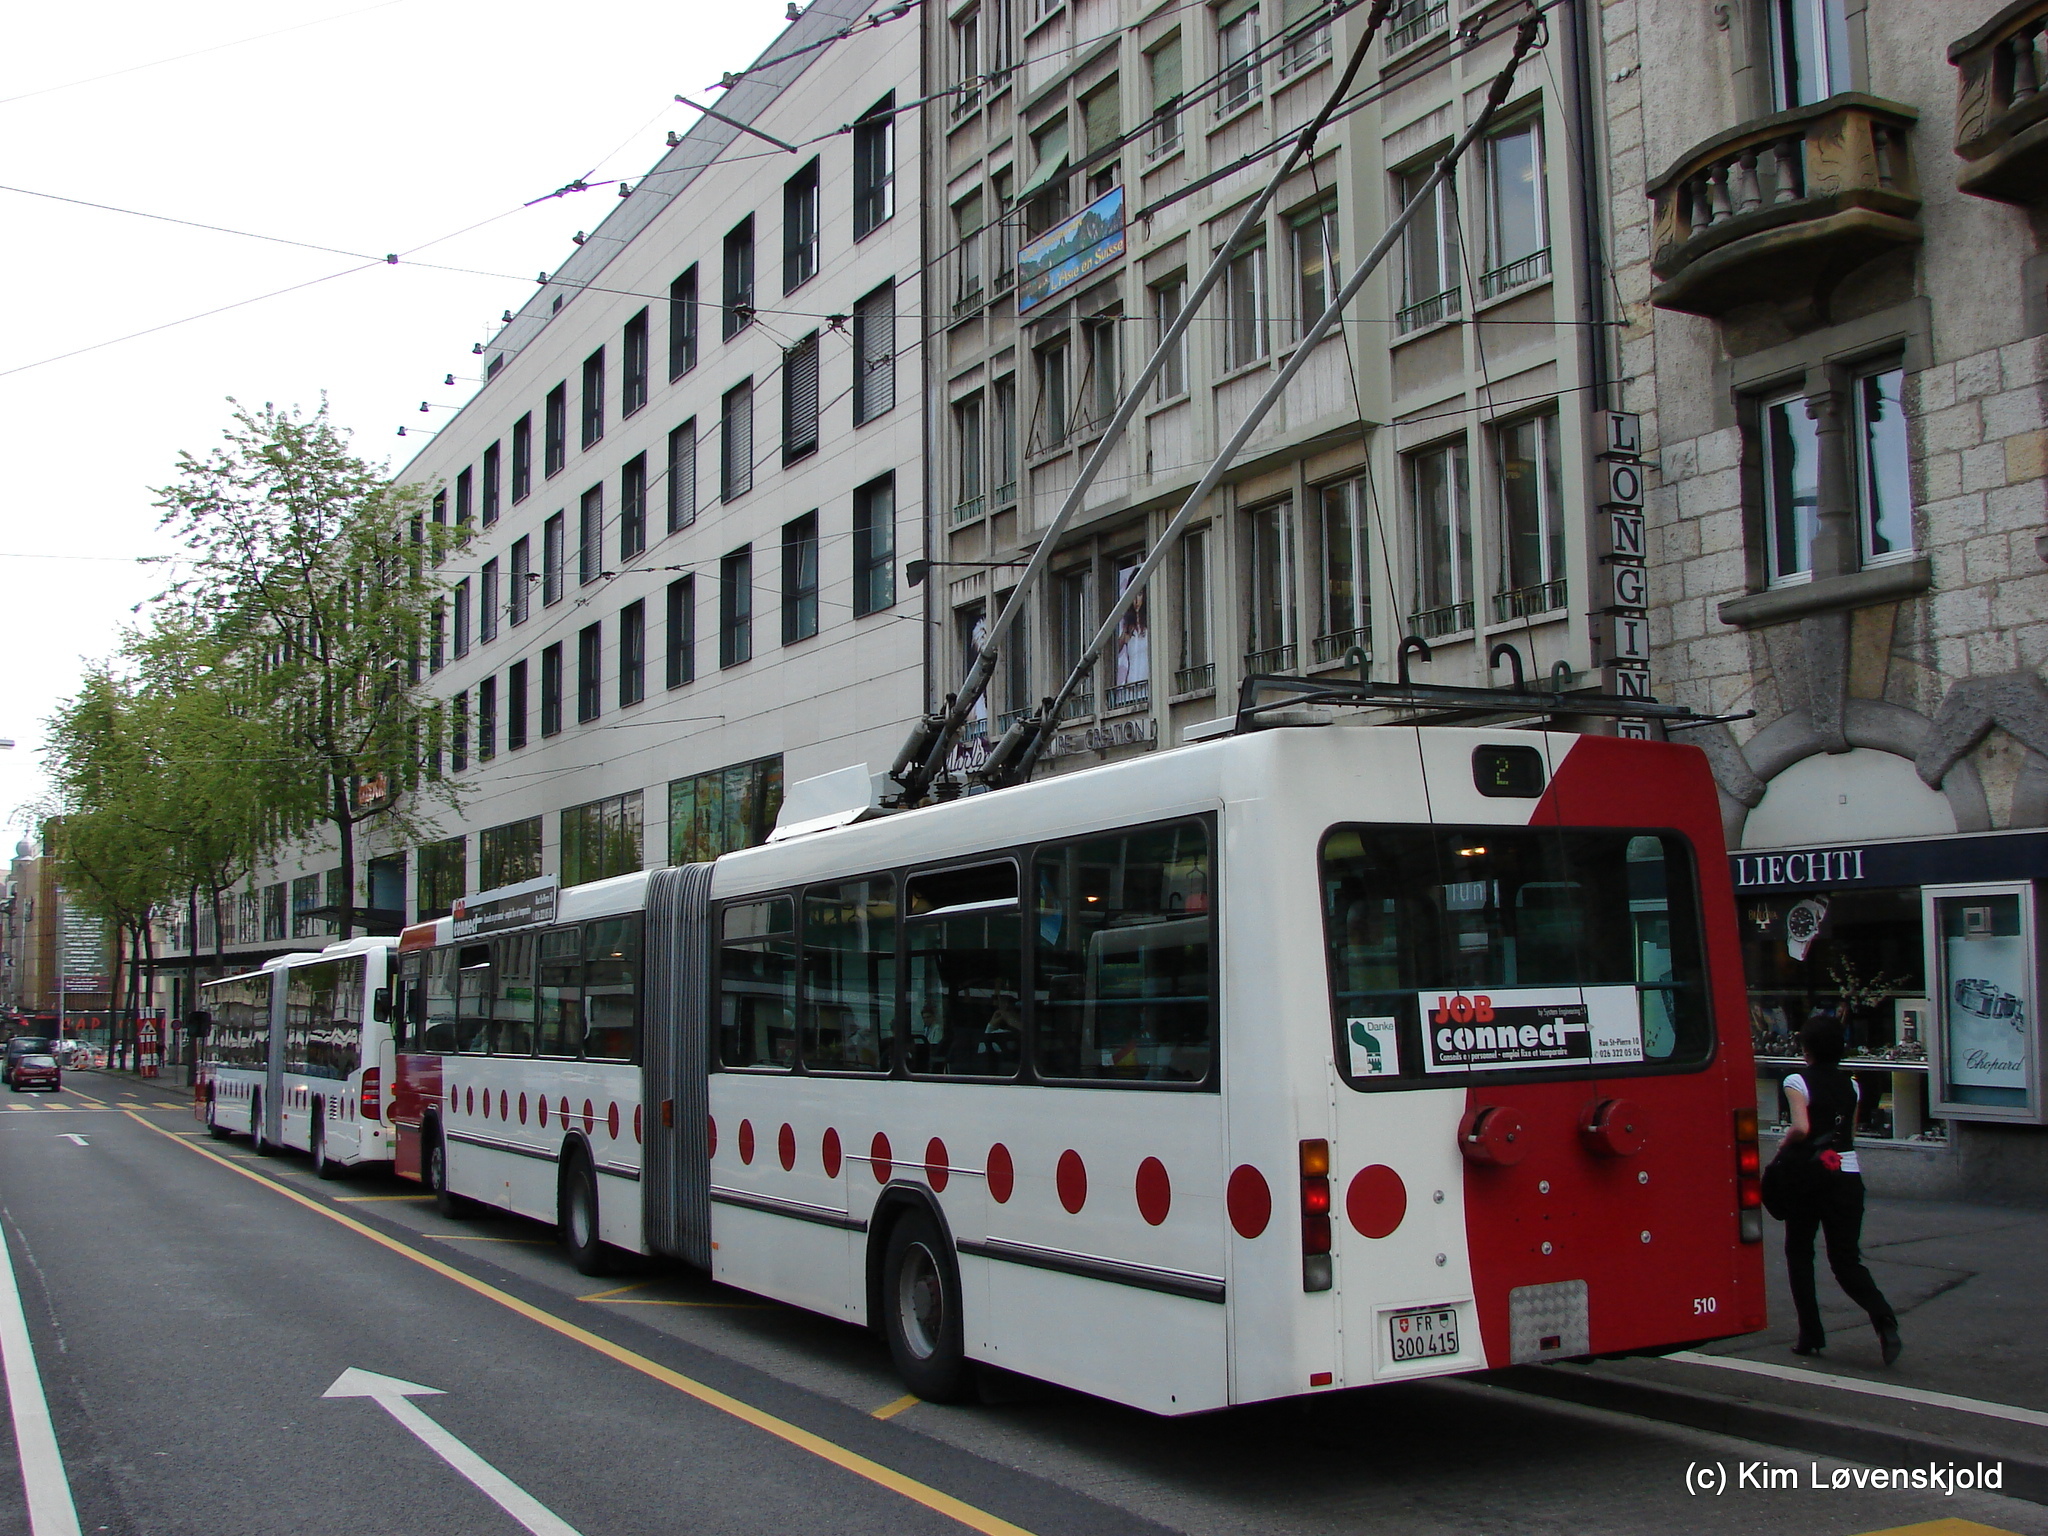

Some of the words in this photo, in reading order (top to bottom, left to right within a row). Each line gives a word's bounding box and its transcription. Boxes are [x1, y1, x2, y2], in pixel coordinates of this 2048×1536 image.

[1081, 257, 1093, 273] en
[1094, 240, 1124, 265] Suisse
[1496, 757, 1509, 785] 2
[1737, 850, 1865, 886] LIECHTI
[1435, 995, 1495, 1024] JOB
[1367, 1021, 1394, 1031] Danke
[1437, 1017, 1582, 1052] connect
[1471, 1050, 1497, 1062] personnel
[1502, 1048, 1520, 1060] emploi
[1539, 1047, 1568, 1058] temporaire
[1598, 1039, 1608, 1047] Rue
[1632, 1036, 1639, 1045] 10
[1600, 1049, 1611, 1058] 026
[1612, 1048, 1623, 1057] 322
[1624, 1048, 1632, 1057] 05
[1633, 1047, 1640, 1056] 05
[1963, 1048, 2025, 1074] Chopard
[1693, 1297, 1716, 1315] 510
[1416, 1316, 1432, 1332] FR
[1397, 1335, 1424, 1358] 300
[1428, 1331, 1456, 1354] 415
